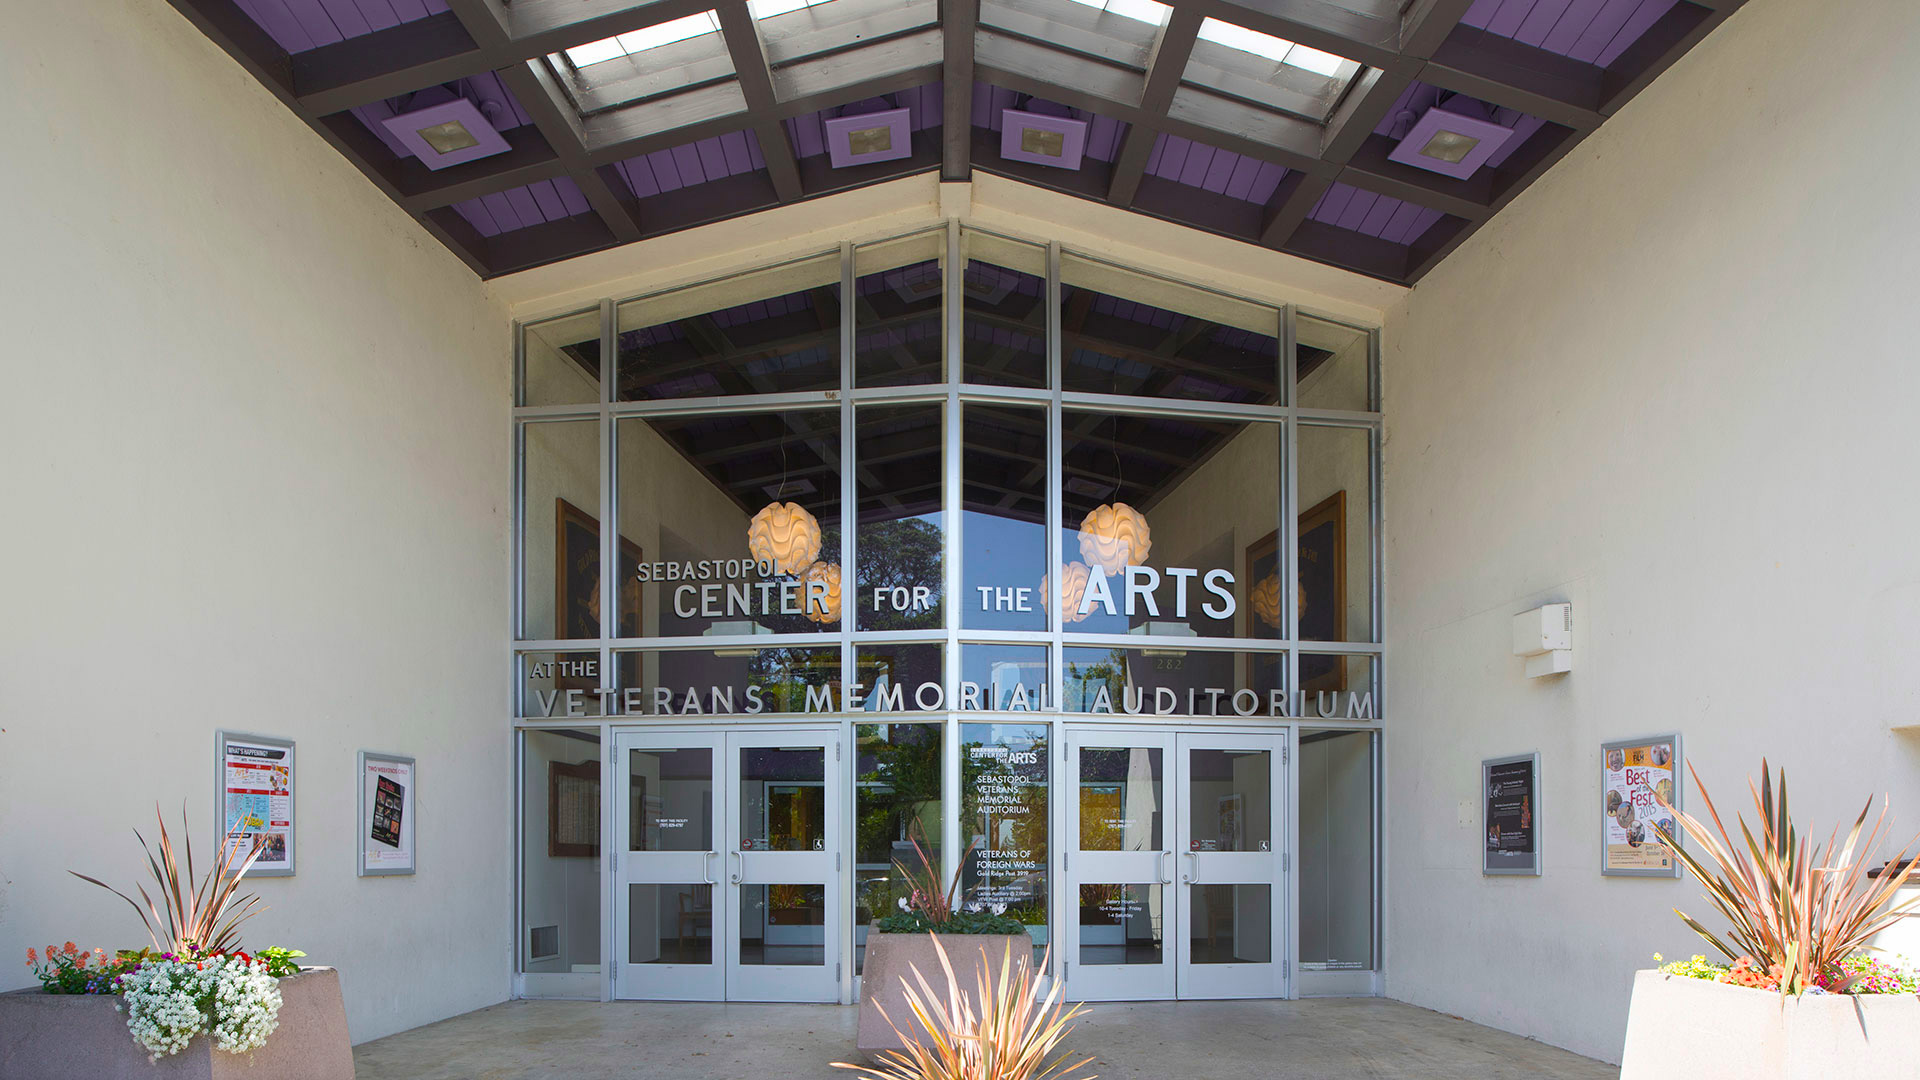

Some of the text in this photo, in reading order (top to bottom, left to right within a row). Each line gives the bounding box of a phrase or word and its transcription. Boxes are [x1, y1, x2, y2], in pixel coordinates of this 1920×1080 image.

[637, 558, 787, 582] SEBASTOPOL
[674, 564, 1237, 620] CENTER FOR THE ARTS
[530, 660, 598, 679] AT THE
[535, 682, 1374, 720] VETERANS MEMORIAL AUDITORIUM
[1008, 752, 1037, 764] ARTS
[977, 775, 1031, 784] SEBASTOPOL
[1626, 768, 1650, 785] Best
[977, 785, 1019, 794] VETERANS
[977, 795, 1022, 804] MEMORIAL
[1630, 789, 1653, 806] Fest
[977, 805, 1030, 814] AUDITORIUM
[977, 850, 1031, 859] VETERANS OF
[976, 860, 1036, 869] FOREIGN WARS
